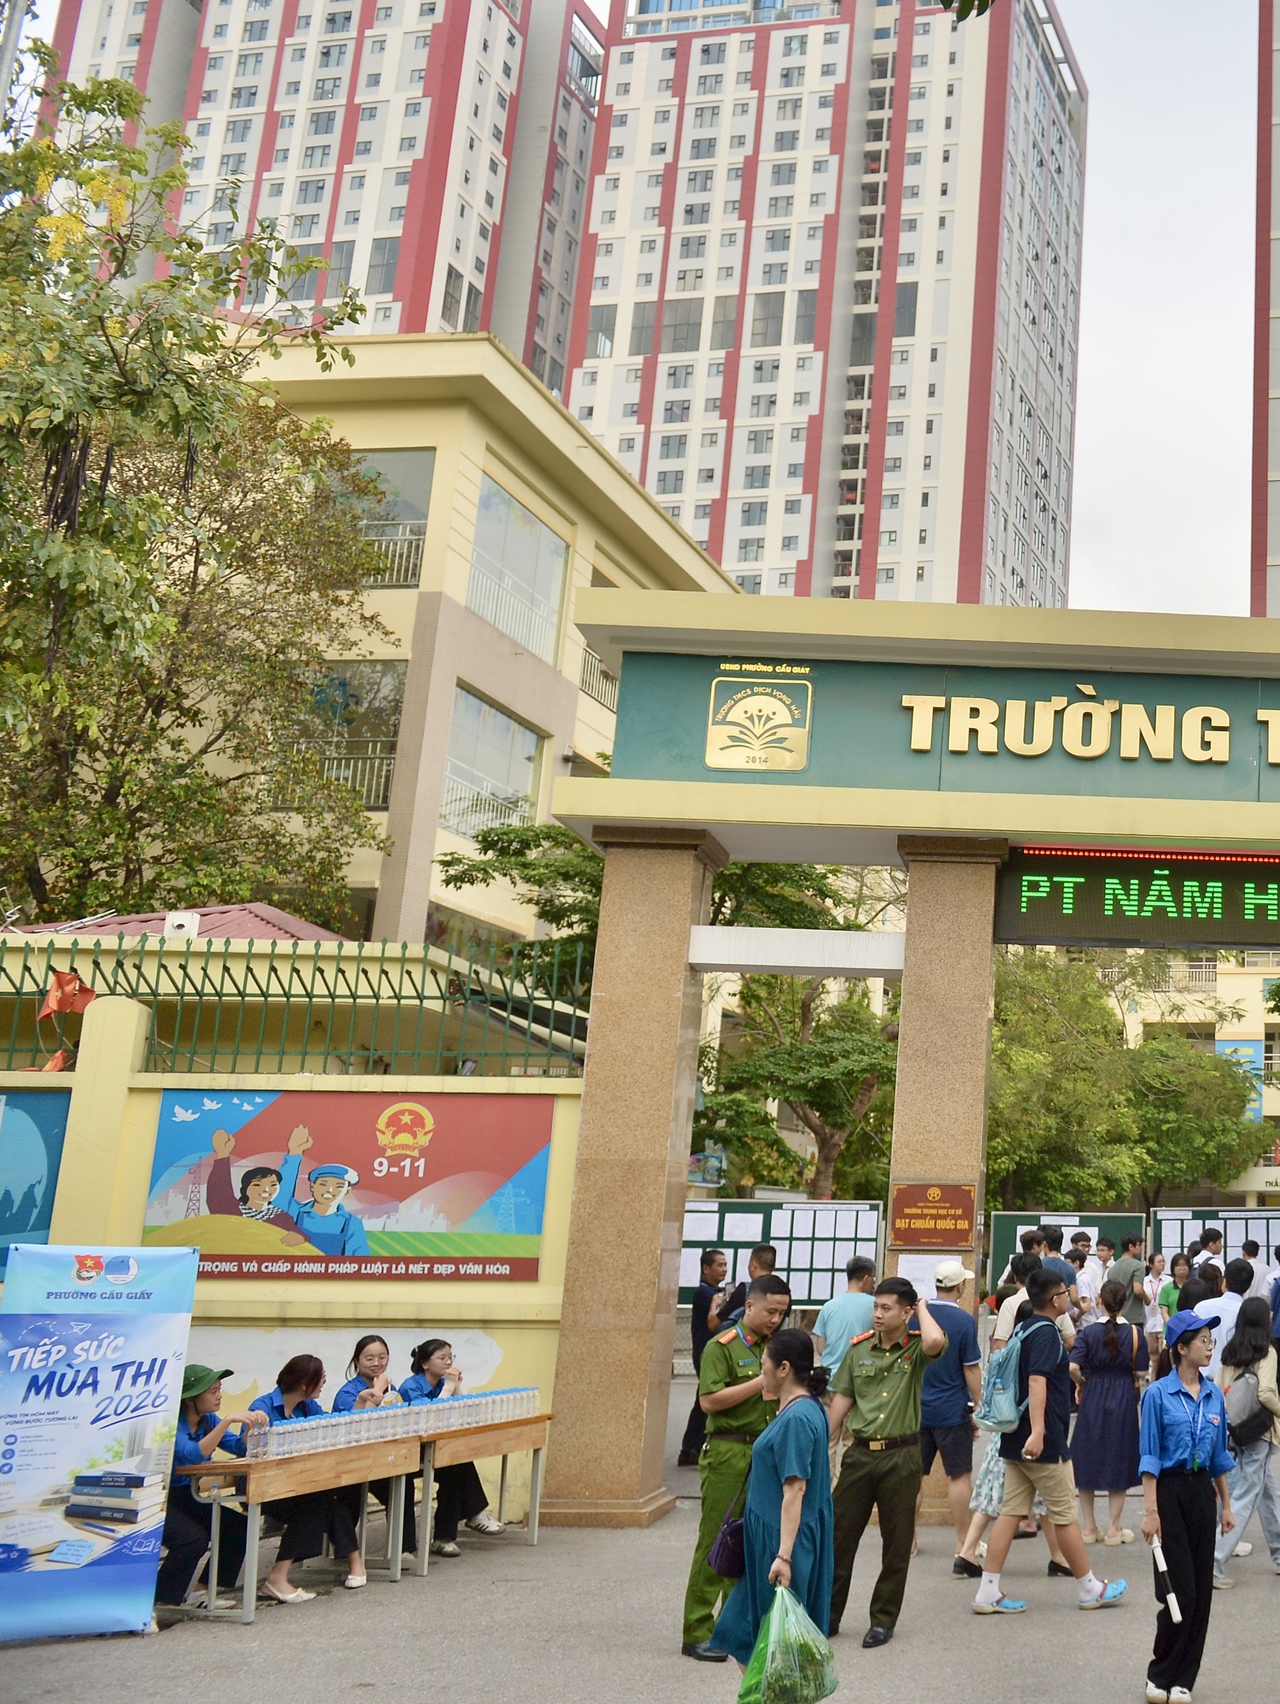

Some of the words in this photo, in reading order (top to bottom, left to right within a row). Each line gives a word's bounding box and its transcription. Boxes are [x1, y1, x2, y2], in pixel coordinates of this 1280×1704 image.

[720, 663, 740, 671] UBND
[733, 687, 751, 701] THCS
[901, 684, 1230, 764] TRƯỜNG
[745, 756, 768, 764] 2014
[1020, 875, 1086, 913] PT
[1104, 869, 1222, 919] NĂM
[373, 1157, 426, 1177] 9-11
[895, 1219, 909, 1230] ĐẠT
[936, 1217, 955, 1230] QUỐC
[956, 1220, 969, 1229] GIA
[198, 1262, 238, 1274] TRỌNG
[241, 1261, 258, 1272] VÀ
[261, 1259, 291, 1273] CHẤP
[293, 1261, 325, 1273] HÀNH
[328, 1261, 358, 1274] PHÁP
[360, 1261, 389, 1276] LUẬT
[391, 1262, 405, 1274] LÀ
[408, 1262, 430, 1274] NÉT
[433, 1263, 455, 1277] ĐẸP
[459, 1262, 482, 1275] VĂN
[485, 1262, 510, 1275] HÓA
[46, 1290, 97, 1300] PHƯỜNG
[126, 1290, 153, 1300] GIẤY
[8, 1336, 67, 1373] TIẾP
[72, 1332, 126, 1365] SỨC
[20, 1363, 100, 1406] MÙA
[111, 1357, 168, 1394] THI
[90, 1383, 169, 1426] 2026
